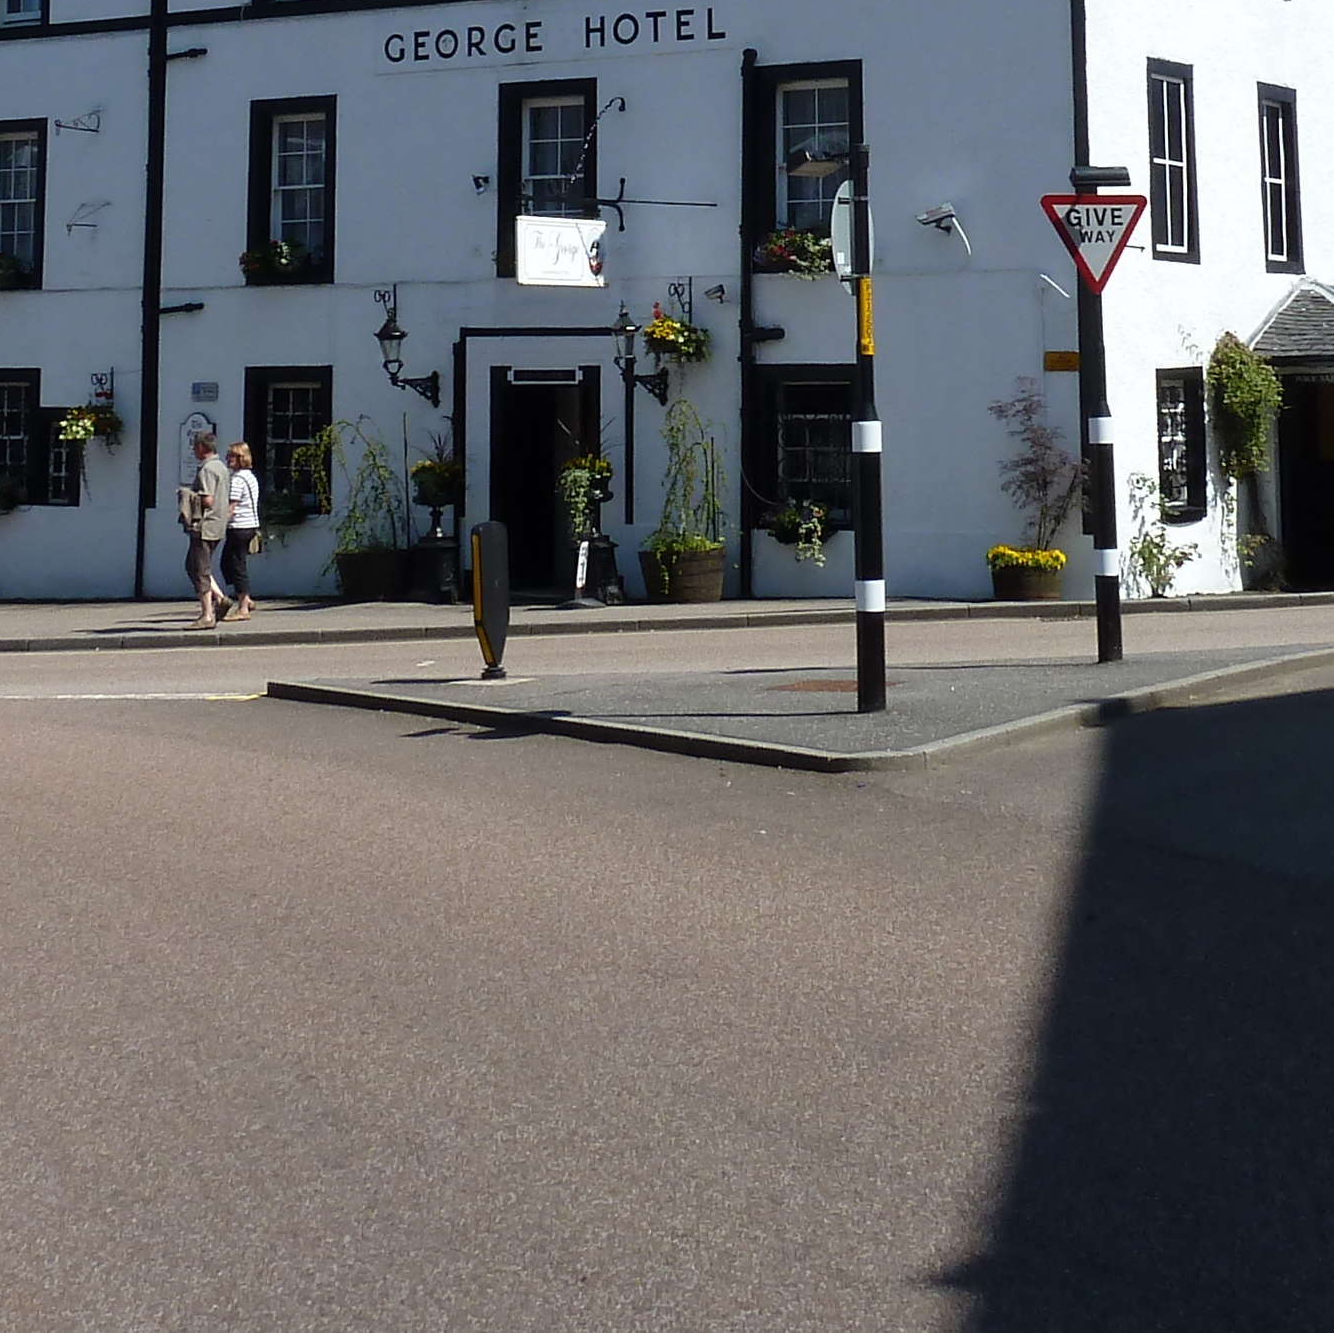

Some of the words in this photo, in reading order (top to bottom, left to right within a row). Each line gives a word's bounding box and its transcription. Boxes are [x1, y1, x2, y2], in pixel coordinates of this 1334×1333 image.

[384, 20, 544, 63] GEORGE
[584, 6, 727, 49] HOTEL
[1066, 207, 1124, 228] GIVE
[1079, 229, 1116, 243] WAY
